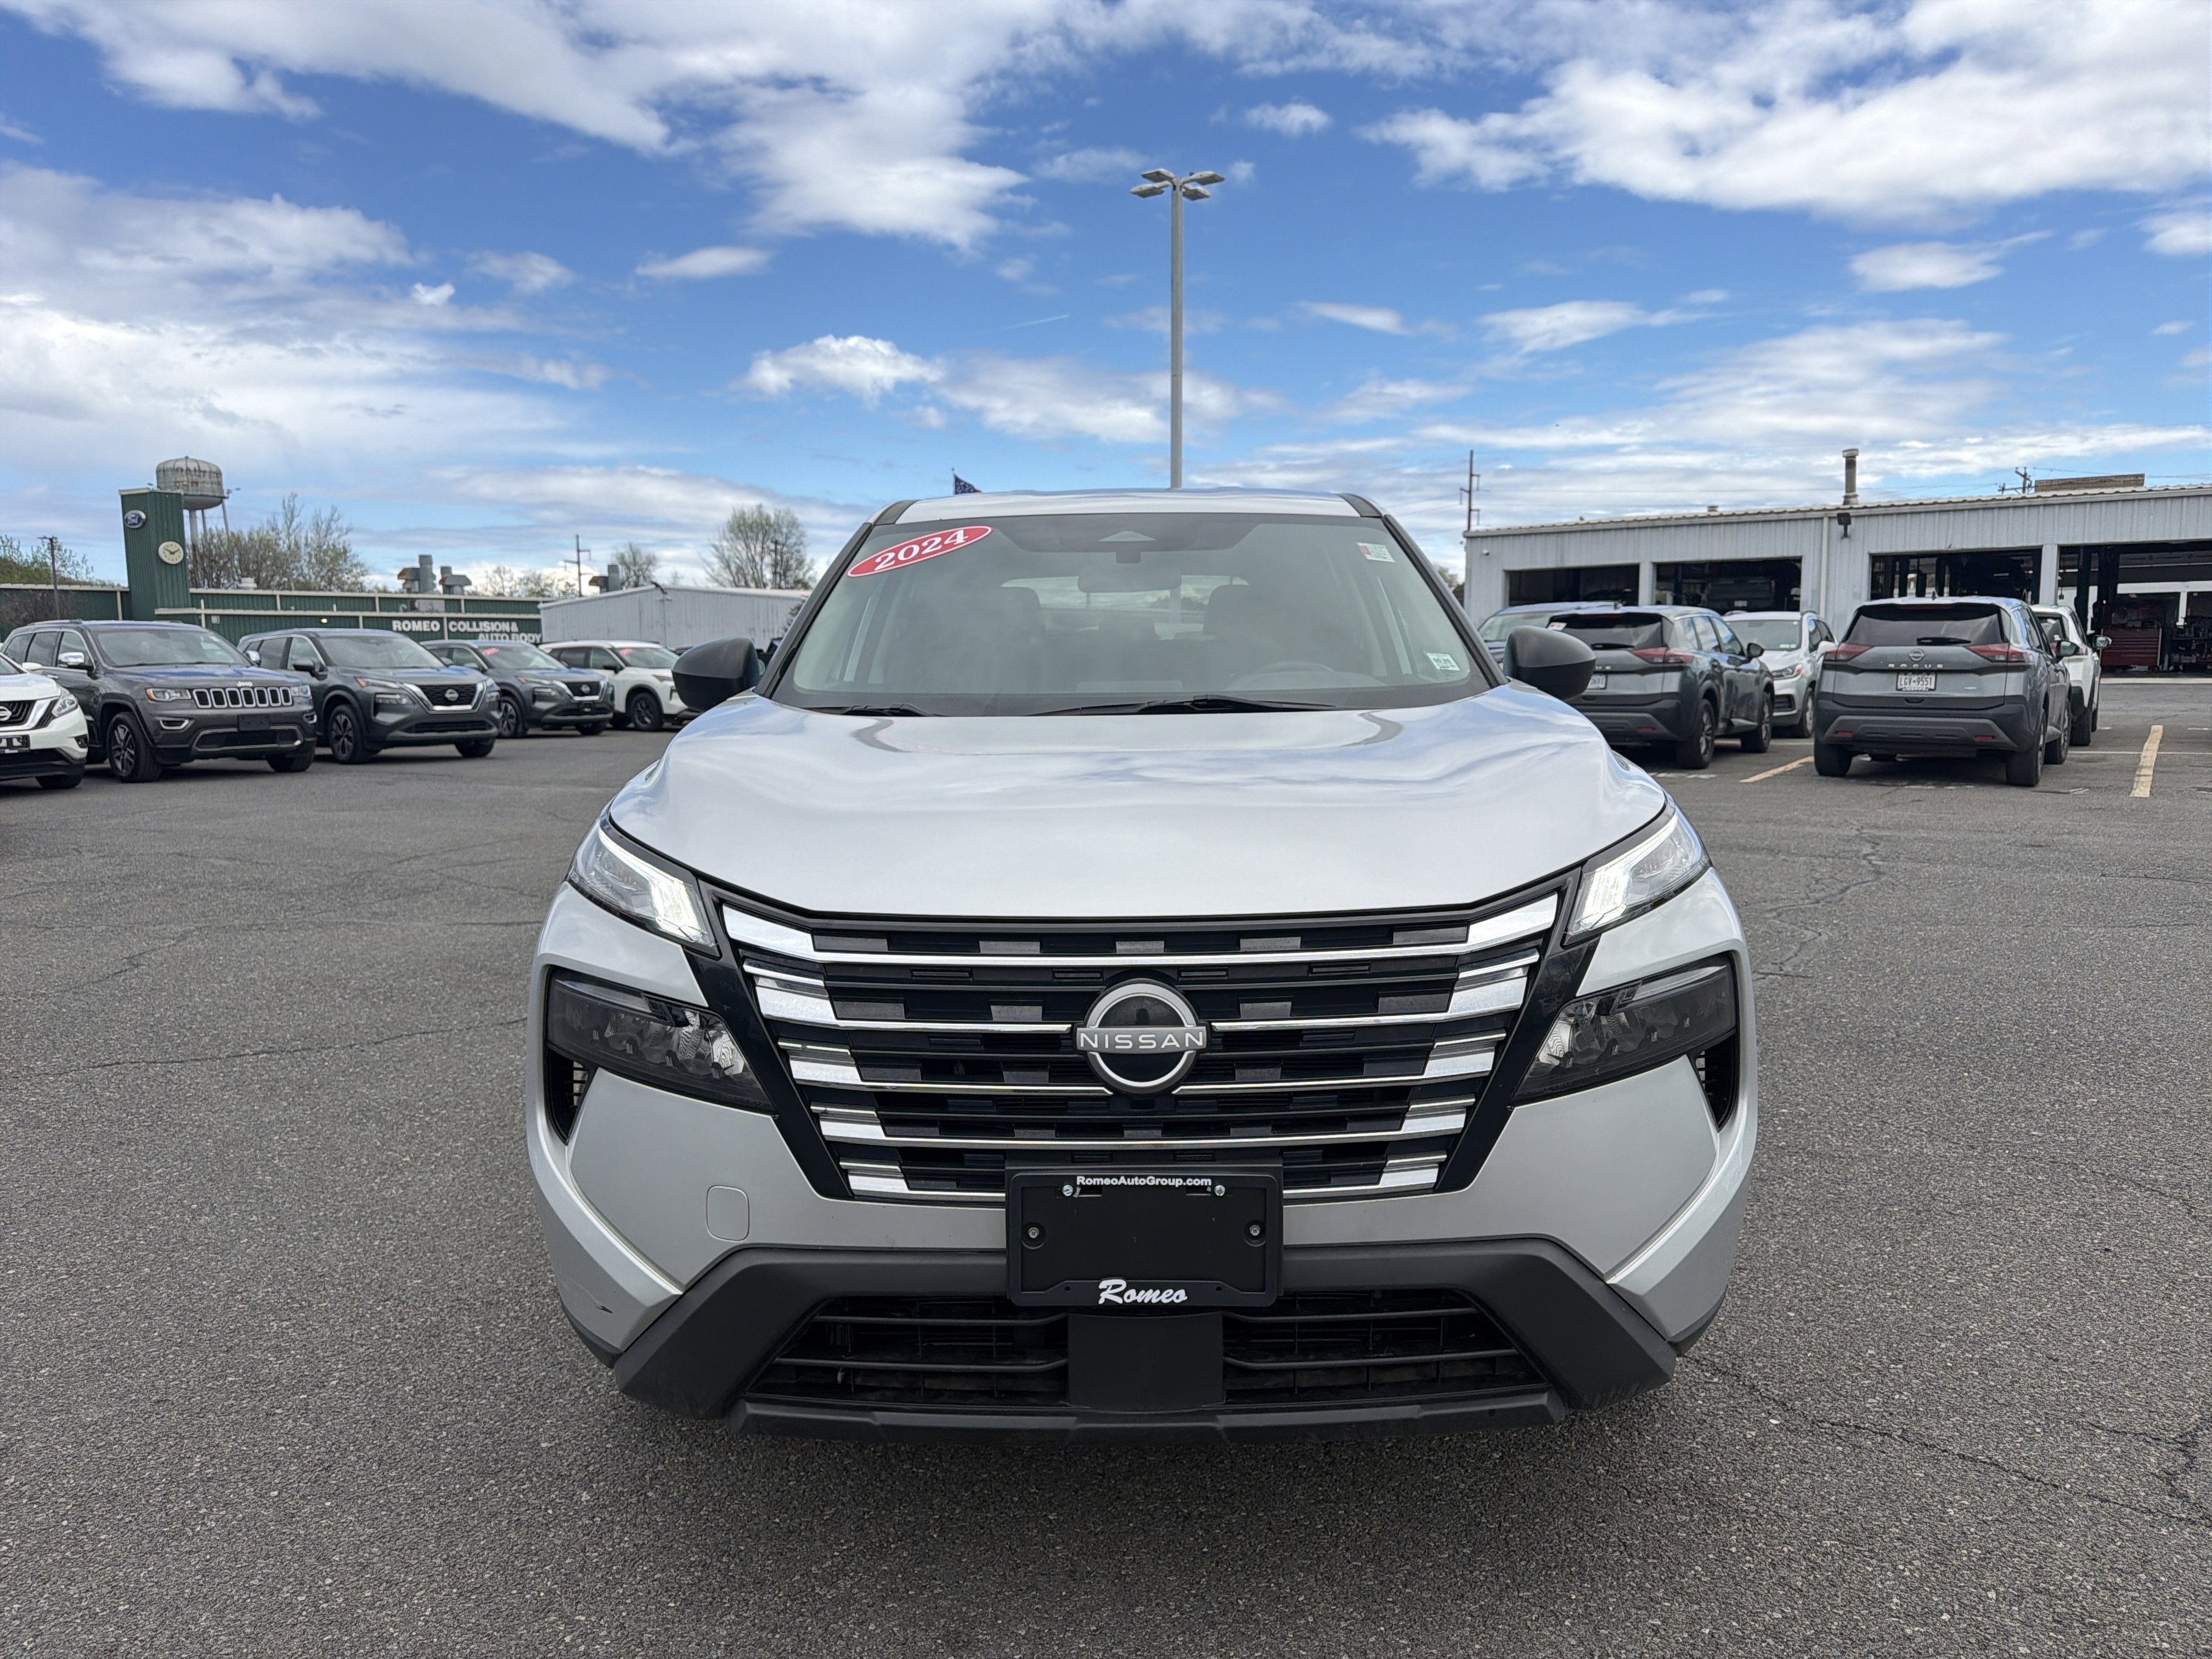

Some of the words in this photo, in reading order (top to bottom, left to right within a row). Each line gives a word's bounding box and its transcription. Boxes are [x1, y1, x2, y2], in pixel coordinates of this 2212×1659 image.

[874, 529, 969, 571] 2024
[392, 619, 441, 631] ROMEO
[448, 620, 510, 633] COLLISION
[478, 632, 510, 641] AUTO
[511, 632, 542, 644] BODY
[1080, 1031, 1204, 1049] NISSAN
[1076, 1176, 1212, 1188] RomeoAutoGroup.com
[1098, 1279, 1188, 1305] Romeo
